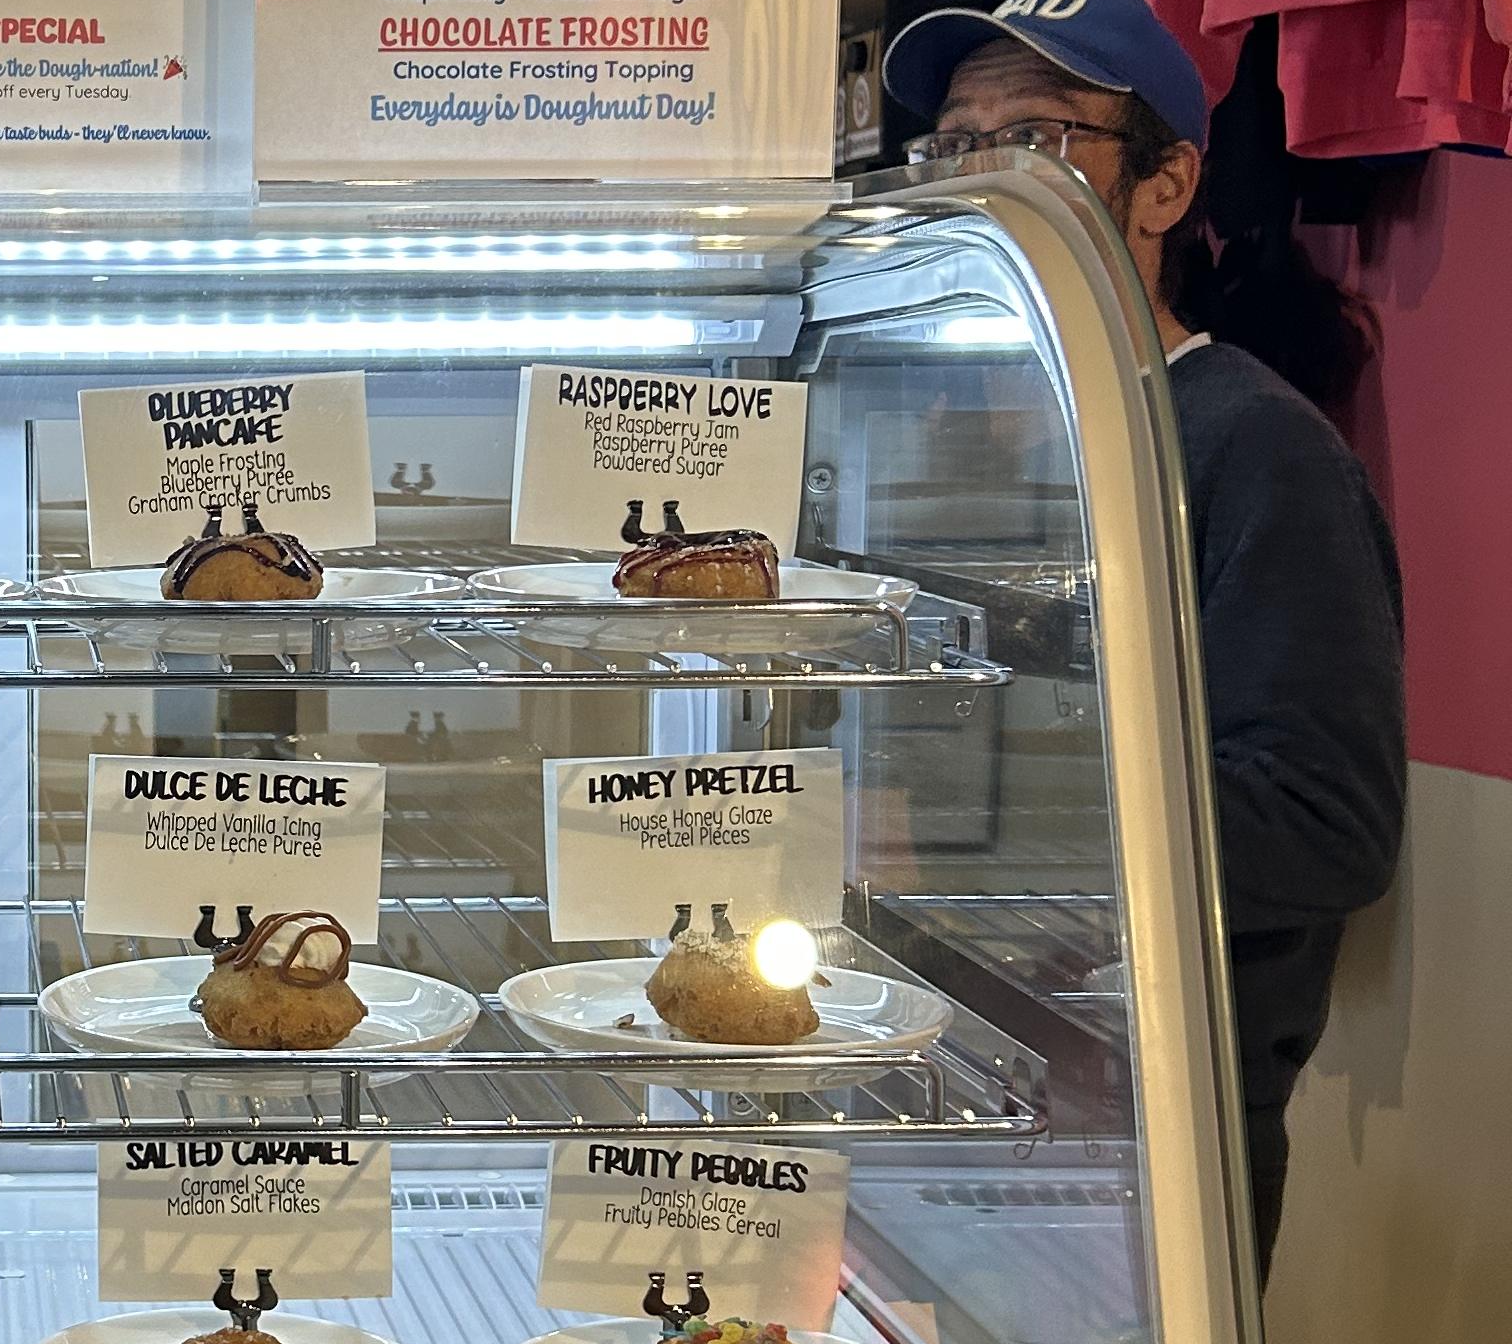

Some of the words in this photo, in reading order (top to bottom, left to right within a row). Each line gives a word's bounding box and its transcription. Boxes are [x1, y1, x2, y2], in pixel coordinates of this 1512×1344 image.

[381, 18, 552, 46] CHOCOLATE
[560, 17, 708, 46] FROSTING
[5, 59, 36, 77] the
[39, 58, 158, 81] Dough-nation!
[394, 61, 502, 79] Chocolate
[510, 60, 597, 83] Frosting
[605, 60, 693, 83] Topping
[371, 92, 493, 126] Everyday
[495, 94, 520, 120] is
[524, 91, 652, 126] Doughnut
[656, 92, 715, 125] Day!
[147, 383, 293, 421] BLUEBERRY
[559, 373, 697, 414] RASPBERRY
[709, 384, 772, 419] LOVE
[164, 414, 283, 450] PANCAKE
[585, 411, 612, 431] Red
[617, 414, 699, 440] Raspberry
[705, 420, 739, 439] Jam
[593, 432, 675, 456] Raspberry
[681, 438, 727, 458] Puree
[594, 451, 671, 473] Powdered
[676, 456, 724, 479] Sugar
[125, 770, 208, 800] DULCE
[216, 772, 251, 802] DE
[259, 773, 349, 807] LECHE
[589, 770, 676, 803] HONEY
[685, 765, 804, 796] PRETZEL
[146, 811, 216, 834] Whipped
[223, 813, 275, 834] Vanilla
[283, 816, 321, 841] Icing
[145, 831, 188, 851] Dulce
[195, 832, 215, 851] De
[222, 832, 267, 854] Leche
[274, 835, 321, 857] Puree
[126, 1142, 223, 1170] SALTED
[232, 1141, 359, 1166] CARAMEL
[589, 1144, 683, 1179] FRUITY
[691, 1152, 808, 1193] PEBBLES
[641, 1187, 695, 1210] Danish
[702, 1192, 746, 1215] Glaze
[605, 1204, 652, 1229] Fruity
[658, 1208, 720, 1231] Pebbles
[727, 1215, 780, 1238] Cereal
